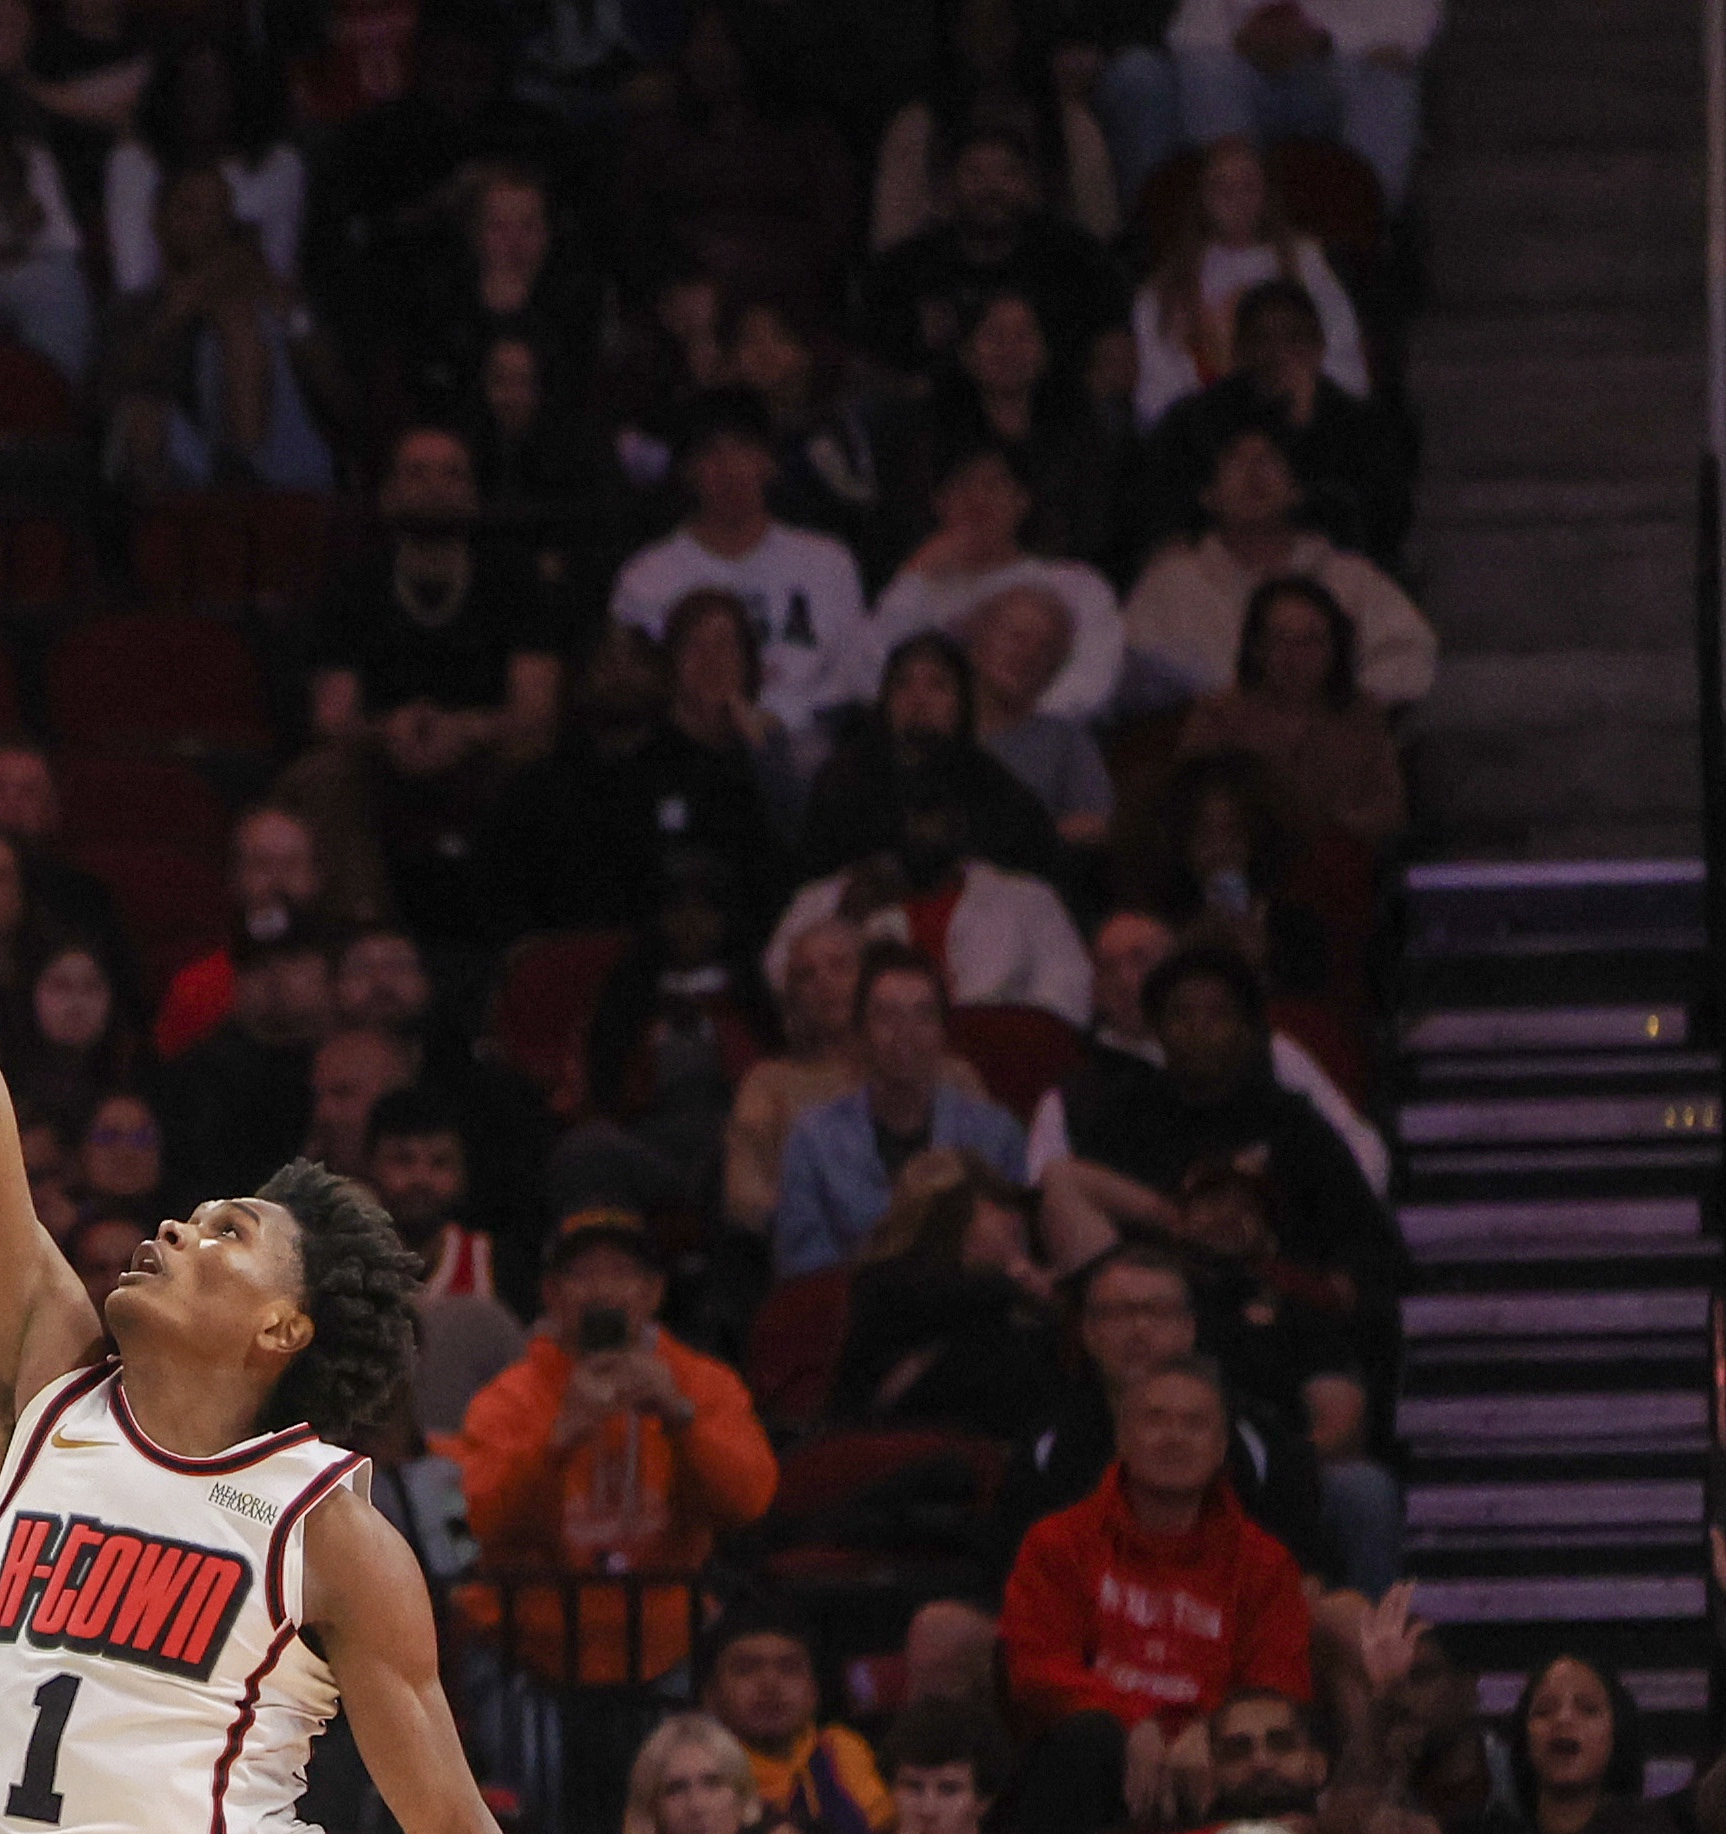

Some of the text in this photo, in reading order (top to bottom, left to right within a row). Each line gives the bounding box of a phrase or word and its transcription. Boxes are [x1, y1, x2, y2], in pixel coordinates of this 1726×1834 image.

[208, 1490, 274, 1525] HERMANN
[212, 1482, 278, 1519] MEMORIAL
[5, 1672, 82, 1825] 1
